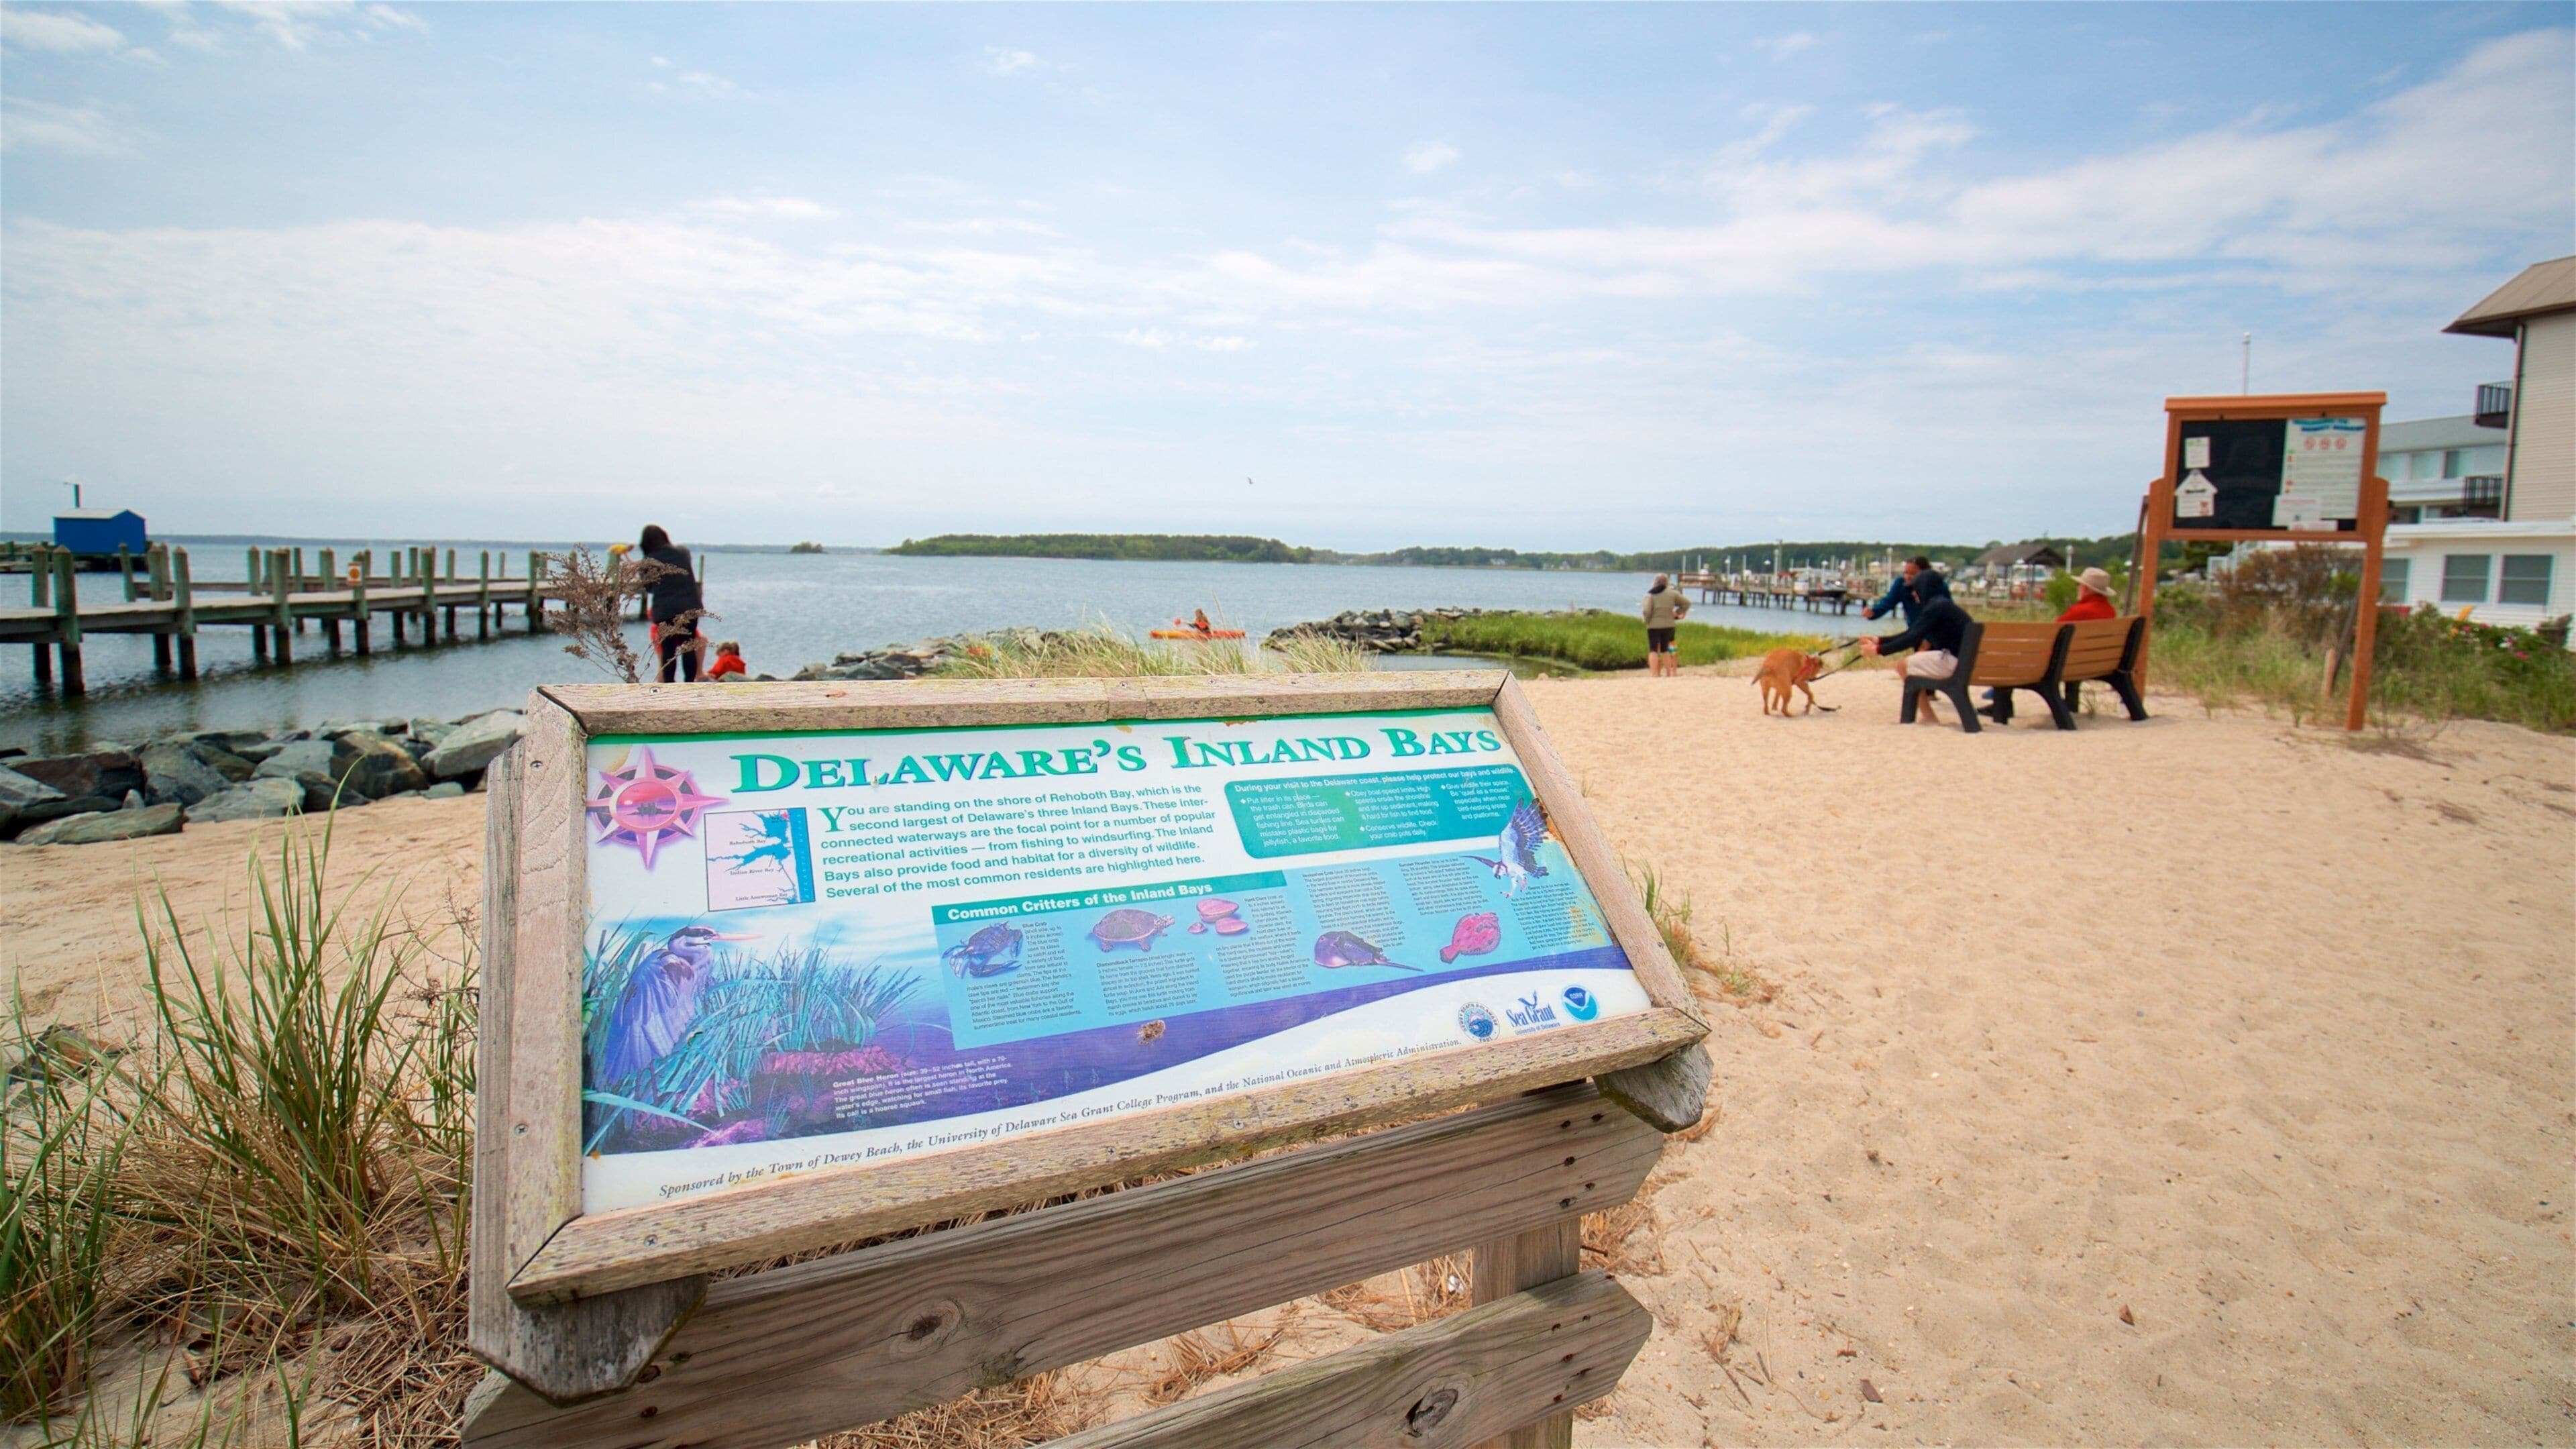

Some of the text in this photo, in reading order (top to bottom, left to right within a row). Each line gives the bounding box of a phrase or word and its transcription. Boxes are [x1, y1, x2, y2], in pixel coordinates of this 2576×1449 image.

[1163, 735, 1369, 770] INLAND
[1381, 729, 1502, 758] BAYS
[849, 818, 899, 830] second
[902, 816, 948, 828] largest
[951, 814, 963, 823] of
[1037, 808, 1068, 817] three
[1071, 804, 1108, 814] Inland
[1110, 804, 1142, 813] Bays.
[1142, 801, 1177, 809] These
[1179, 798, 1208, 806] inter-
[869, 806, 890, 814] are
[894, 801, 950, 812] standing
[973, 798, 993, 807] the
[997, 796, 1032, 805] shore
[1034, 794, 1046, 803] of
[1050, 791, 1107, 802] Rehoboth
[1110, 790, 1134, 799] Bay,
[1136, 786, 1169, 796] which
[1171, 786, 1181, 794] is
[1183, 785, 1201, 793] the
[820, 835, 893, 849] connected
[897, 831, 967, 843] waterways
[970, 829, 990, 837] are
[994, 826, 1013, 835] the
[1016, 823, 1046, 833] focal
[1050, 821, 1081, 833] point
[1083, 820, 1099, 828] for
[1113, 816, 1157, 826] number
[1160, 813, 1171, 822] of
[1173, 811, 1215, 823] popular
[822, 824, 1213, 864] recreational activities from fishing to windsurfing. The Inland
[824, 871, 859, 882] Bays
[864, 867, 893, 877] also
[897, 862, 947, 877] provide
[951, 859, 980, 869] food
[984, 856, 1008, 867] and
[1011, 853, 1055, 864] habitat
[1057, 851, 1074, 860] for
[1088, 846, 1138, 858] diversity
[1142, 843, 1152, 853] of
[1156, 841, 1199, 851] wildlife.
[826, 856, 1205, 898] Several of the most common residents are highlighted here.
[948, 884, 1212, 920] Common Critters of the Inland Bays
[1506, 1009, 1528, 1027] Sea
[1525, 1003, 1556, 1023] Grant
[659, 1040, 1461, 1198] Sponsored by the Town of Dewey Beach, the University of Delaware Sea Grant College Program, and the National Oceanic and Atmospheric Administration.
